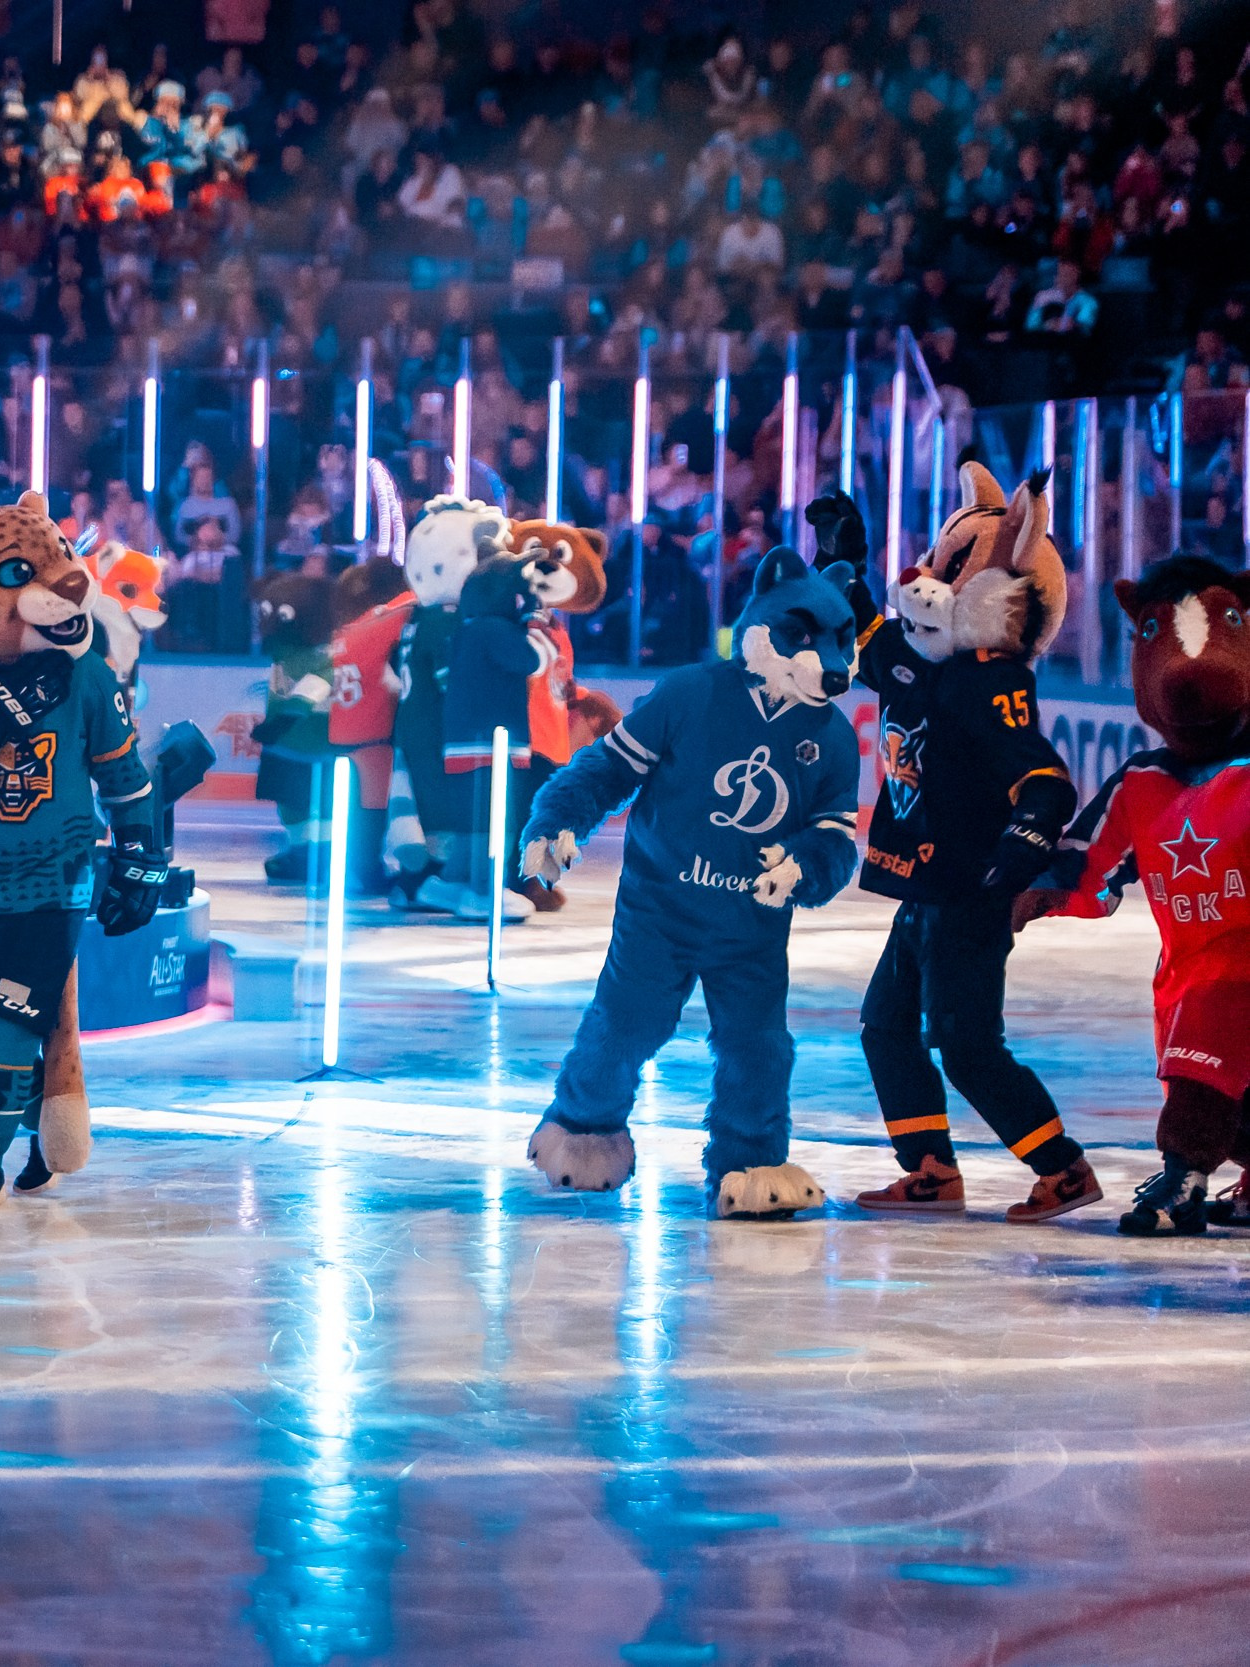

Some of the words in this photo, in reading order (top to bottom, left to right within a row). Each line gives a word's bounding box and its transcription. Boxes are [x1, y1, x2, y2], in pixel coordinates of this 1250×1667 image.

[992, 689, 1029, 728] 35
[679, 854, 753, 893] Моск
[1148, 868, 1246, 923] ЦСКА
